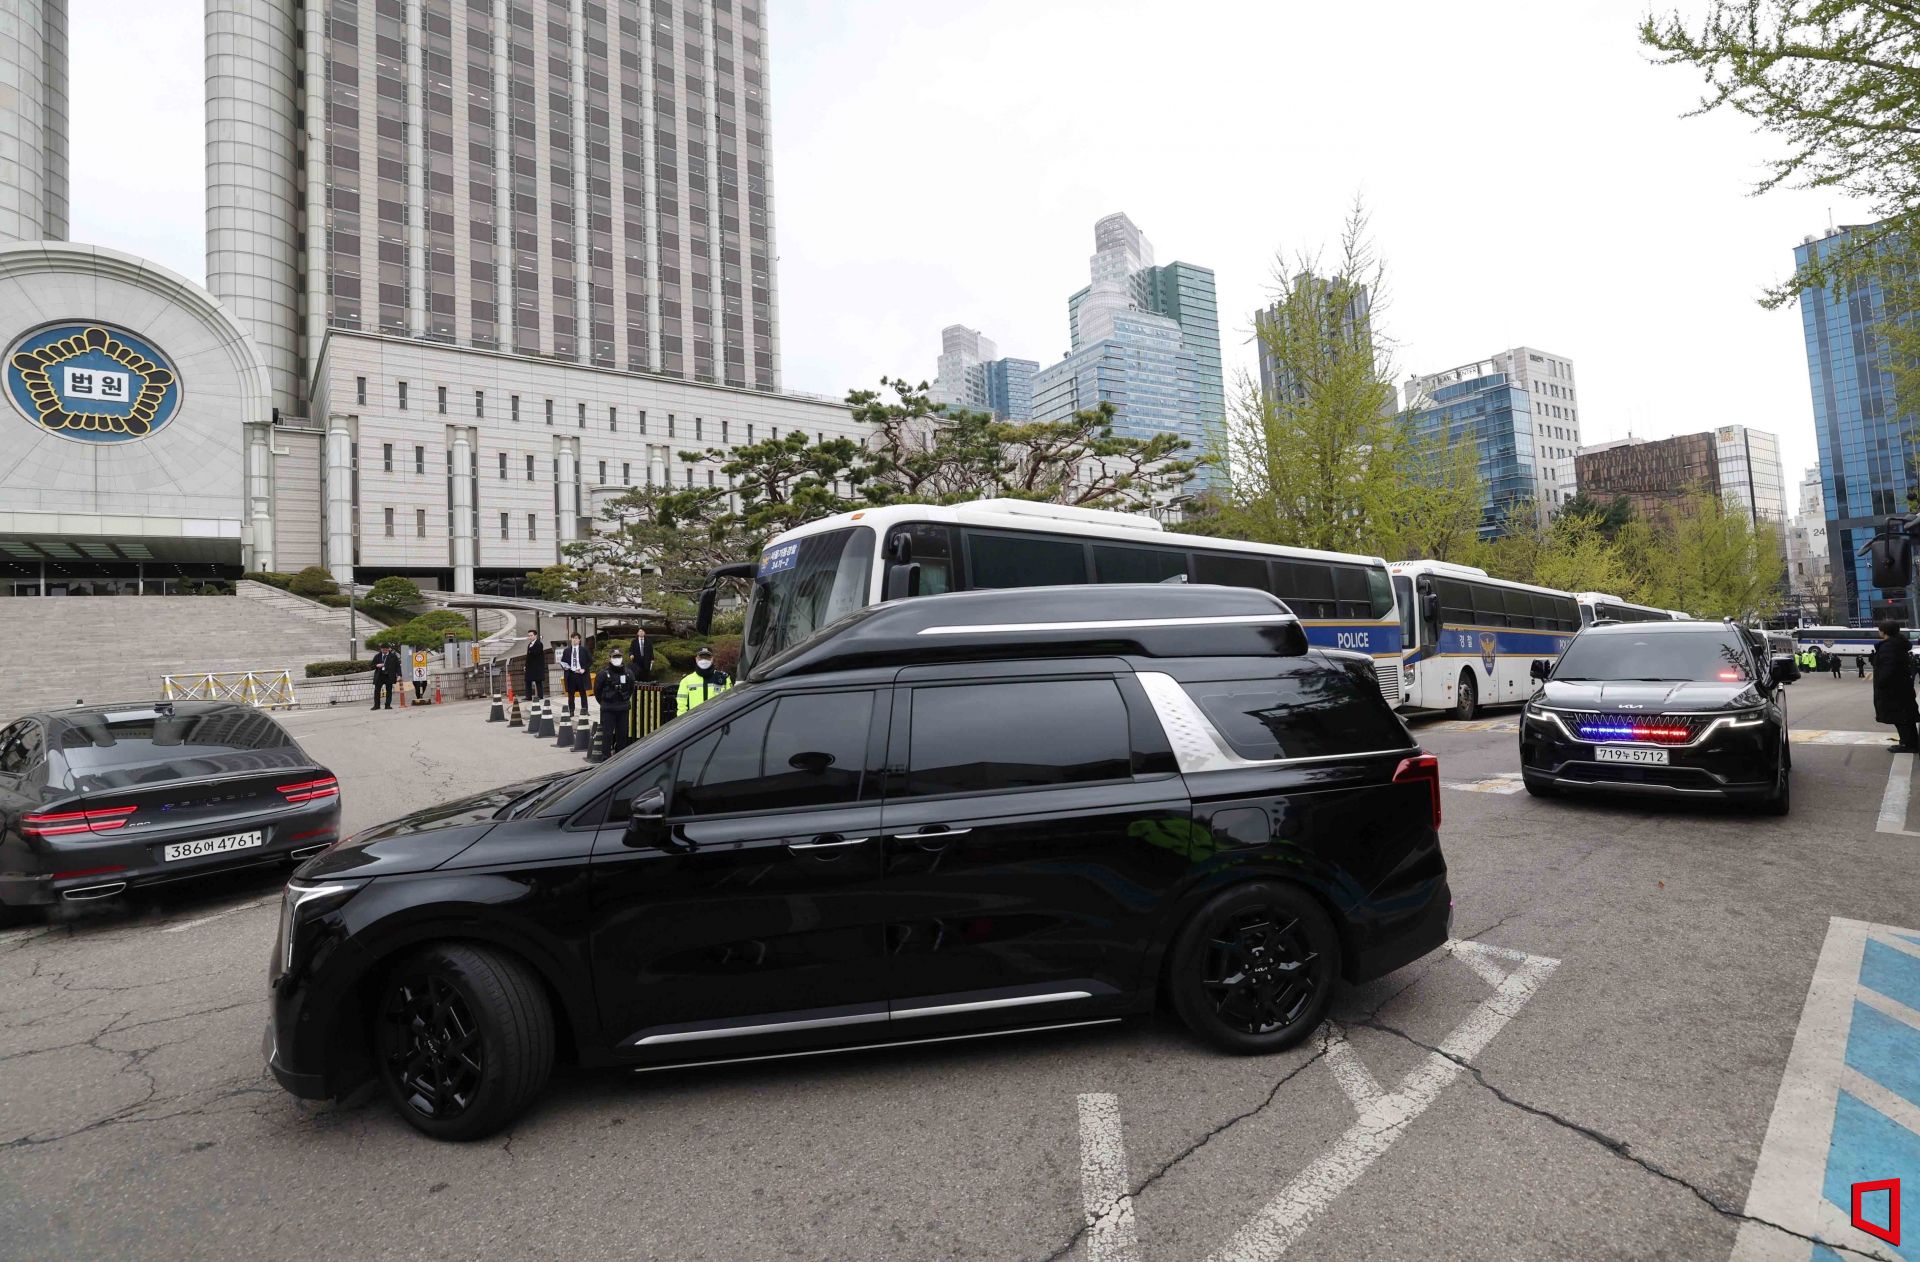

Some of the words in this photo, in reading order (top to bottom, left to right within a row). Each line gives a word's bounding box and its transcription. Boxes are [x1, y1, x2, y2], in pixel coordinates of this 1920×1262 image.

[71, 371, 122, 397] 법원
[1813, 527, 1825, 537] 24
[1337, 632, 1369, 649] POLICE
[1633, 750, 1664, 762] 5712
[217, 833, 255, 850] 4761
